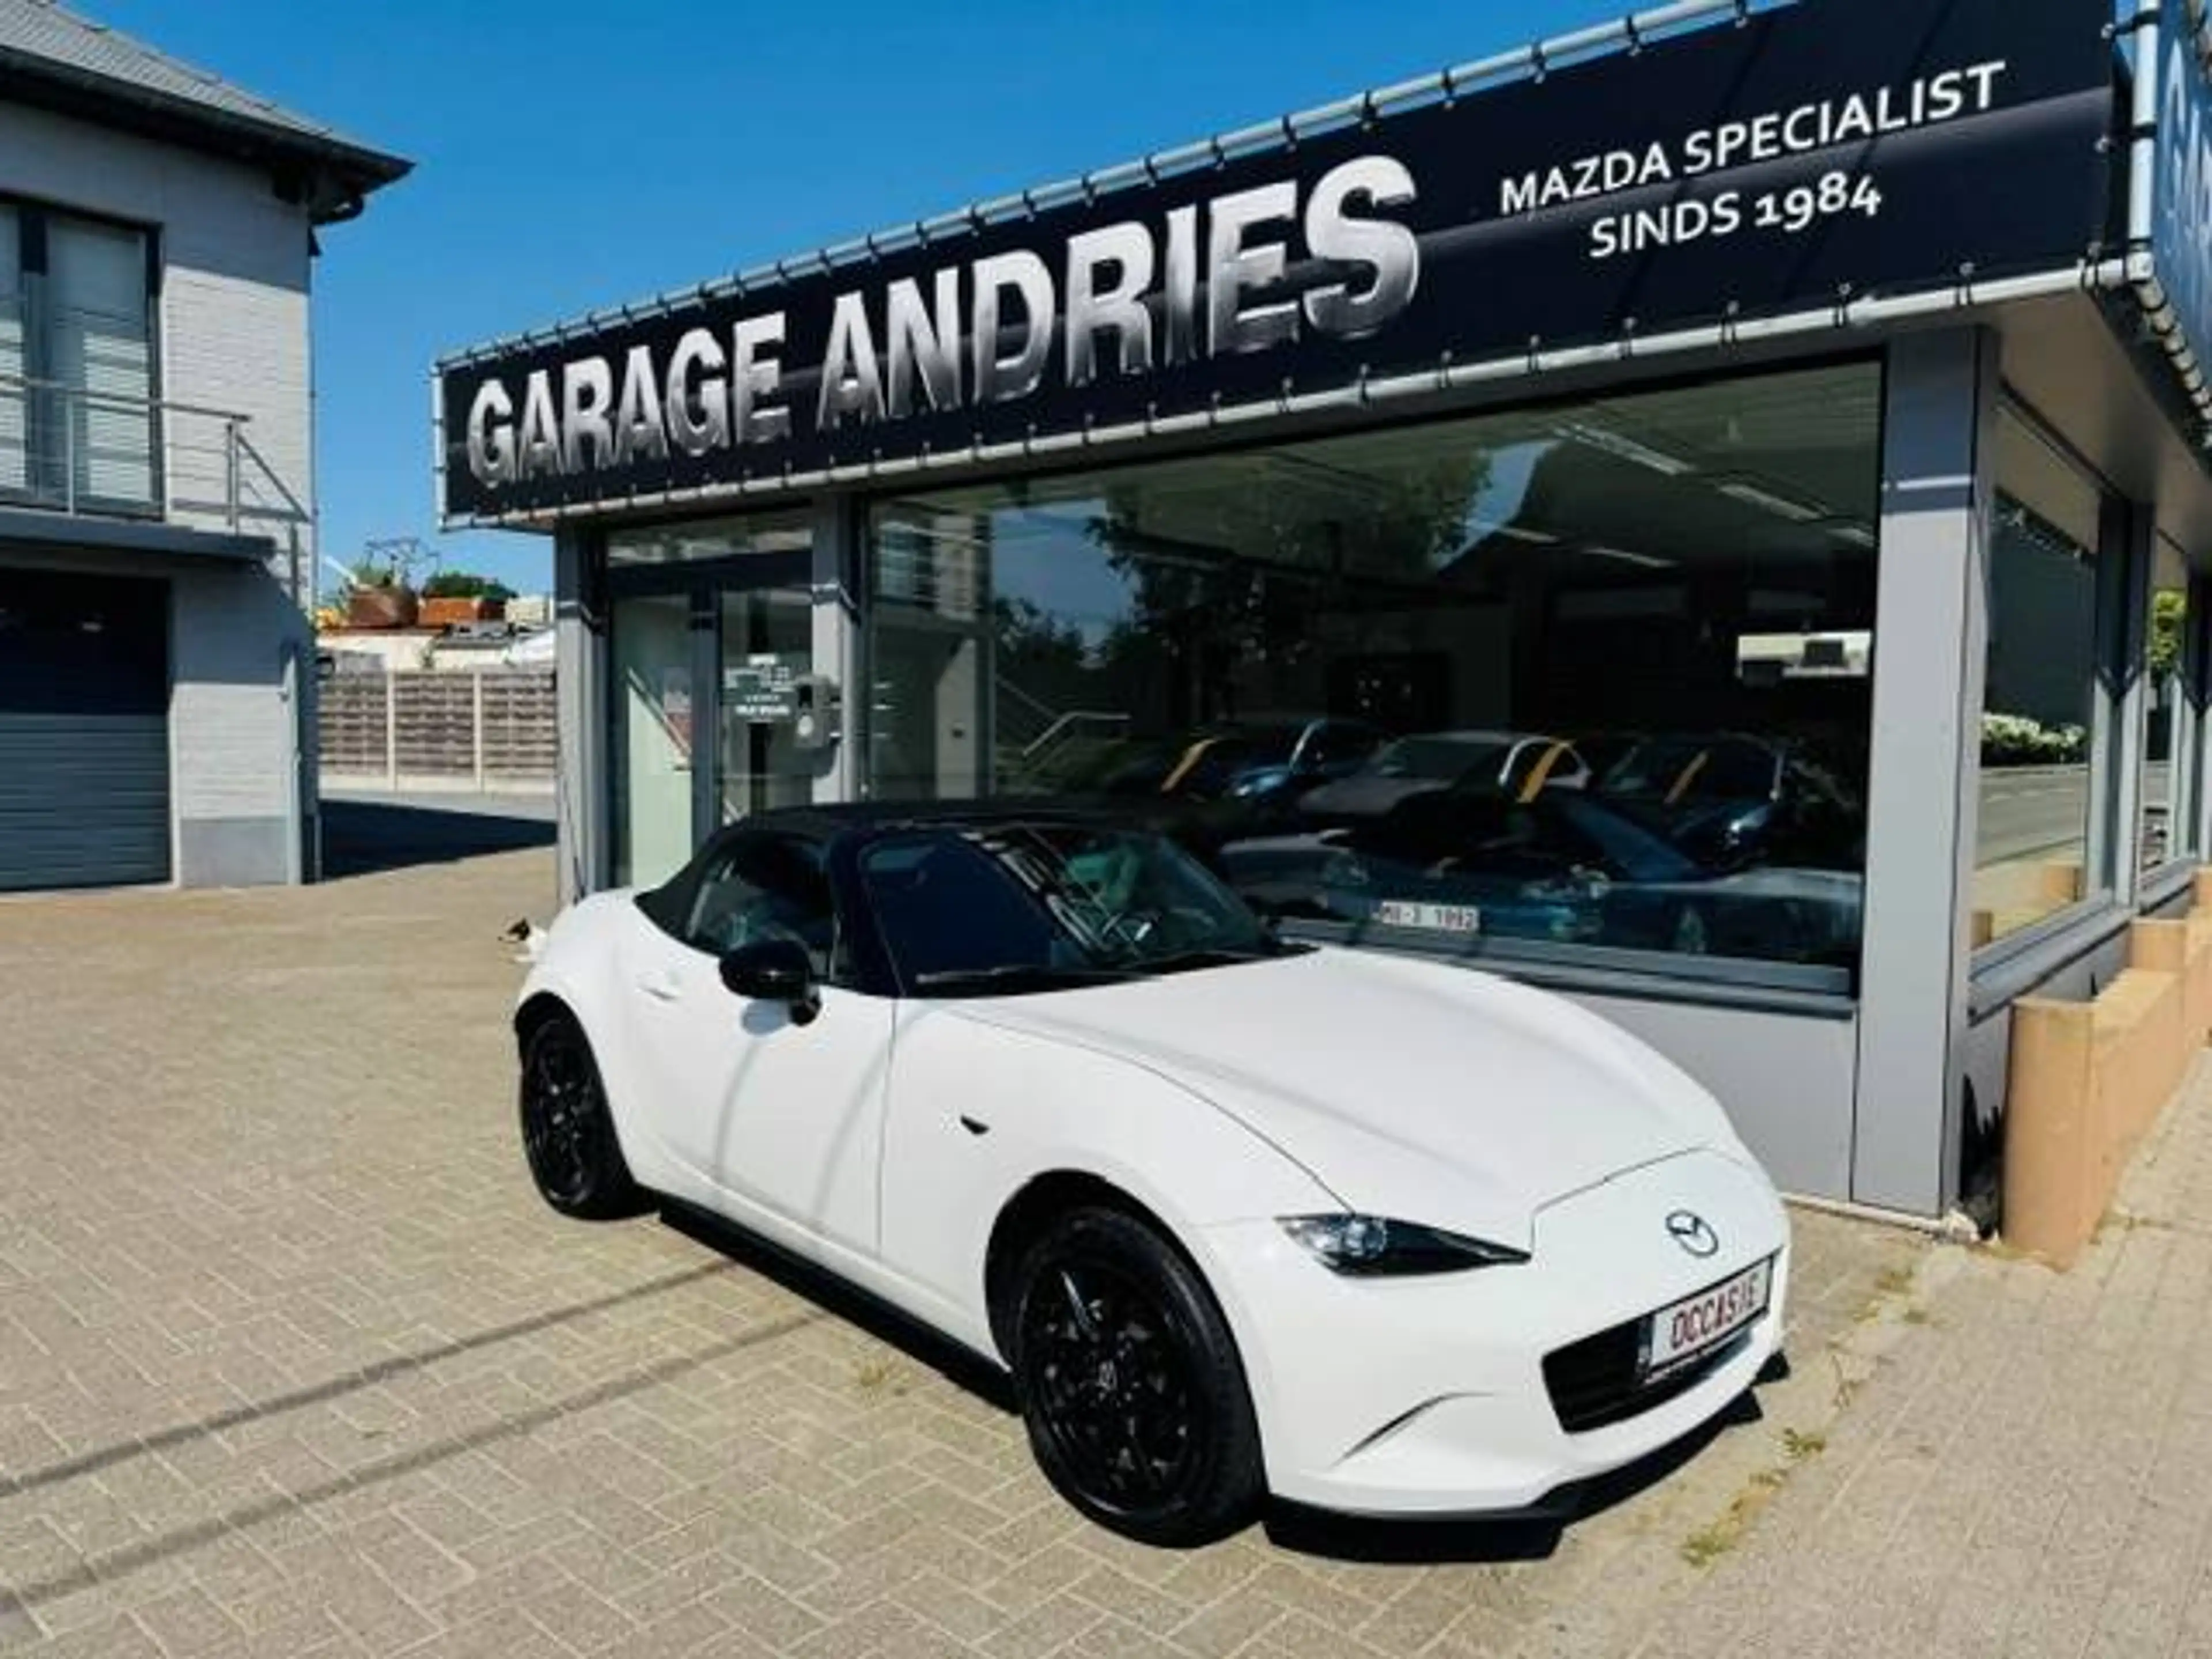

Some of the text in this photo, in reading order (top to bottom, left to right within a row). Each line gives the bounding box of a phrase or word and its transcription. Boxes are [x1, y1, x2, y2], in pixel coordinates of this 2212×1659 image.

[1499, 60, 2006, 214] MAZDA SPECIALIST
[1589, 171, 1883, 257] SINDS 1984
[465, 154, 1421, 488] GARAGE ANDRIES
